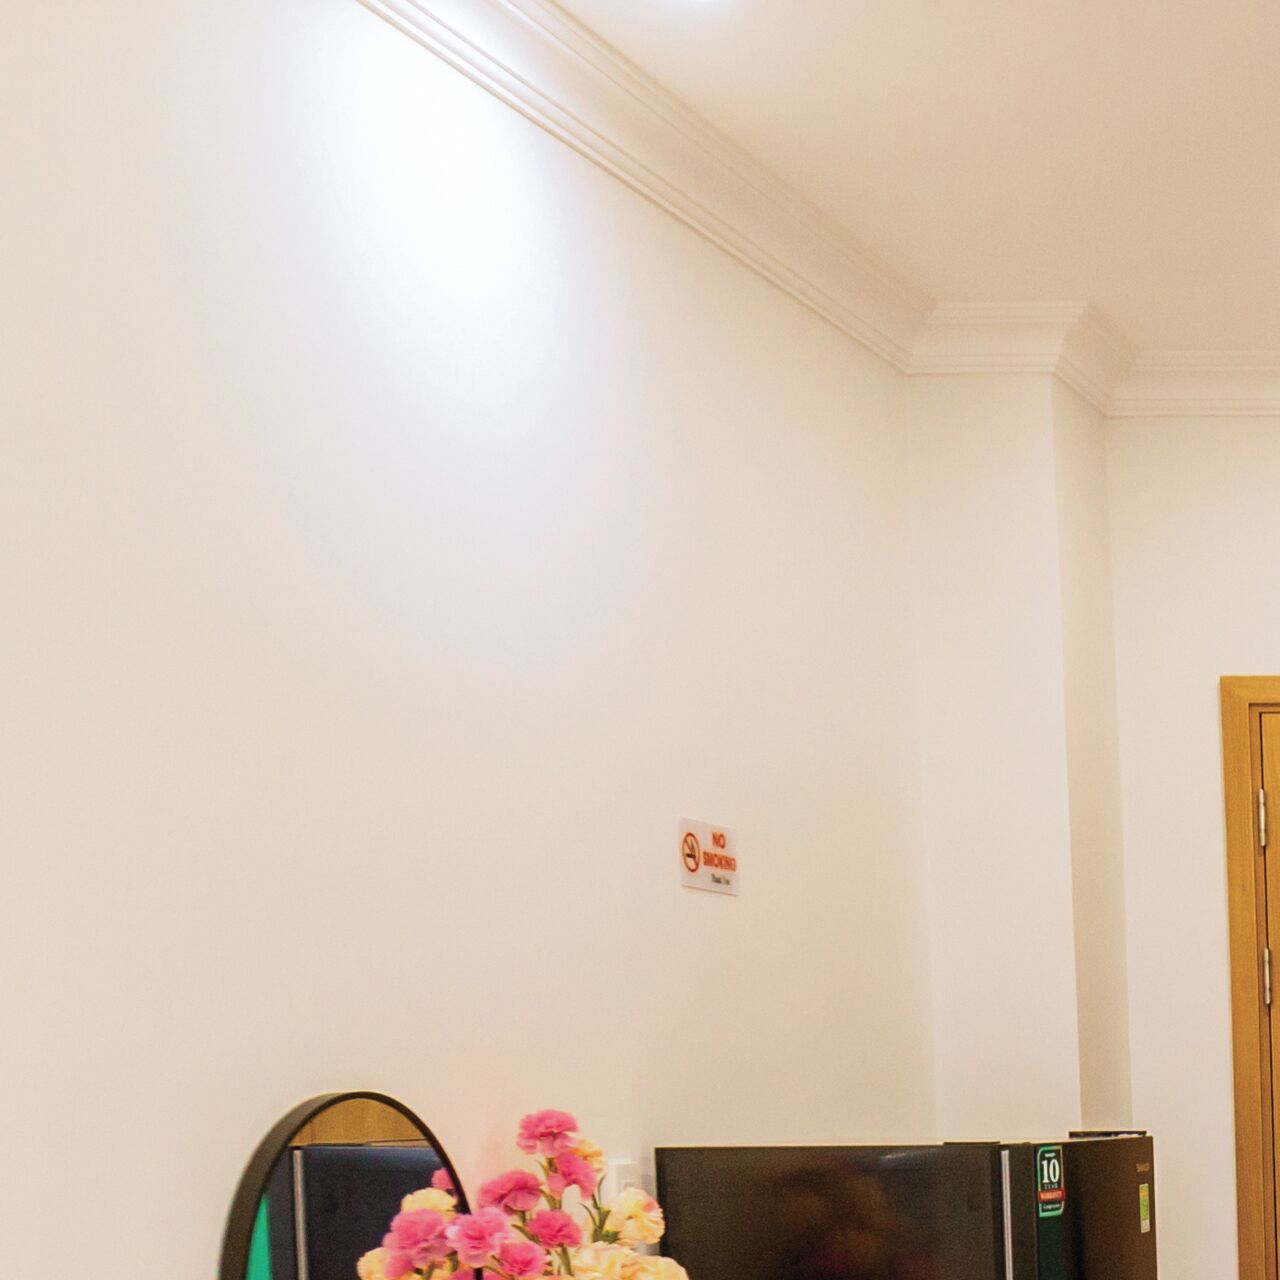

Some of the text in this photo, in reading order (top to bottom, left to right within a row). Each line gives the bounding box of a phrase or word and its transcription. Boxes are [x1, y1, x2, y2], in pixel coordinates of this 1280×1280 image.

[712, 831, 726, 849] NO
[703, 850, 737, 872] SMOKING
[1041, 1158, 1060, 1183] 10
